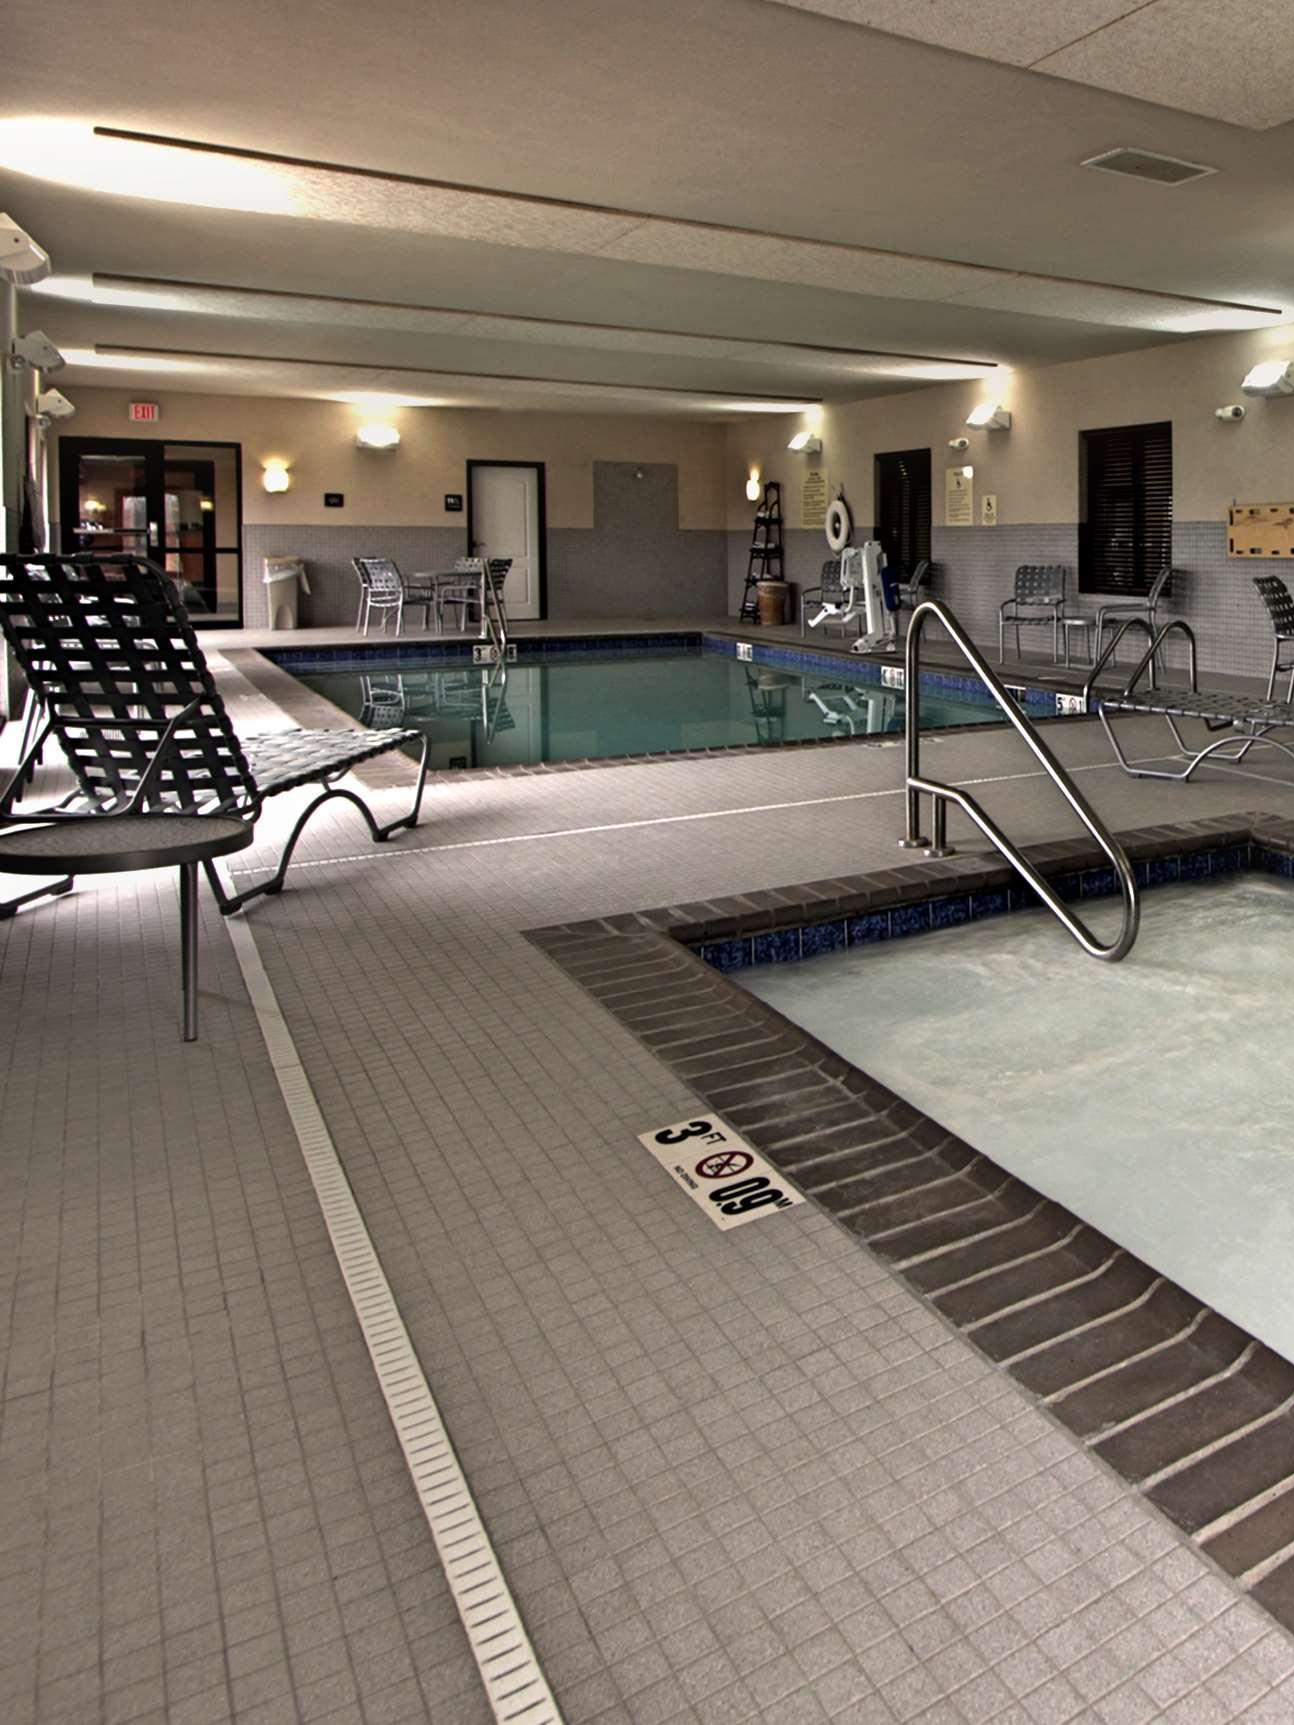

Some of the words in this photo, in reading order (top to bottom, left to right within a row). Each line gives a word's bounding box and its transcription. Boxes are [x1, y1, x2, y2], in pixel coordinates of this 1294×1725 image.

[134, 404, 155, 420] EXIT
[655, 1121, 712, 1145] 3
[701, 1132, 727, 1145] FT
